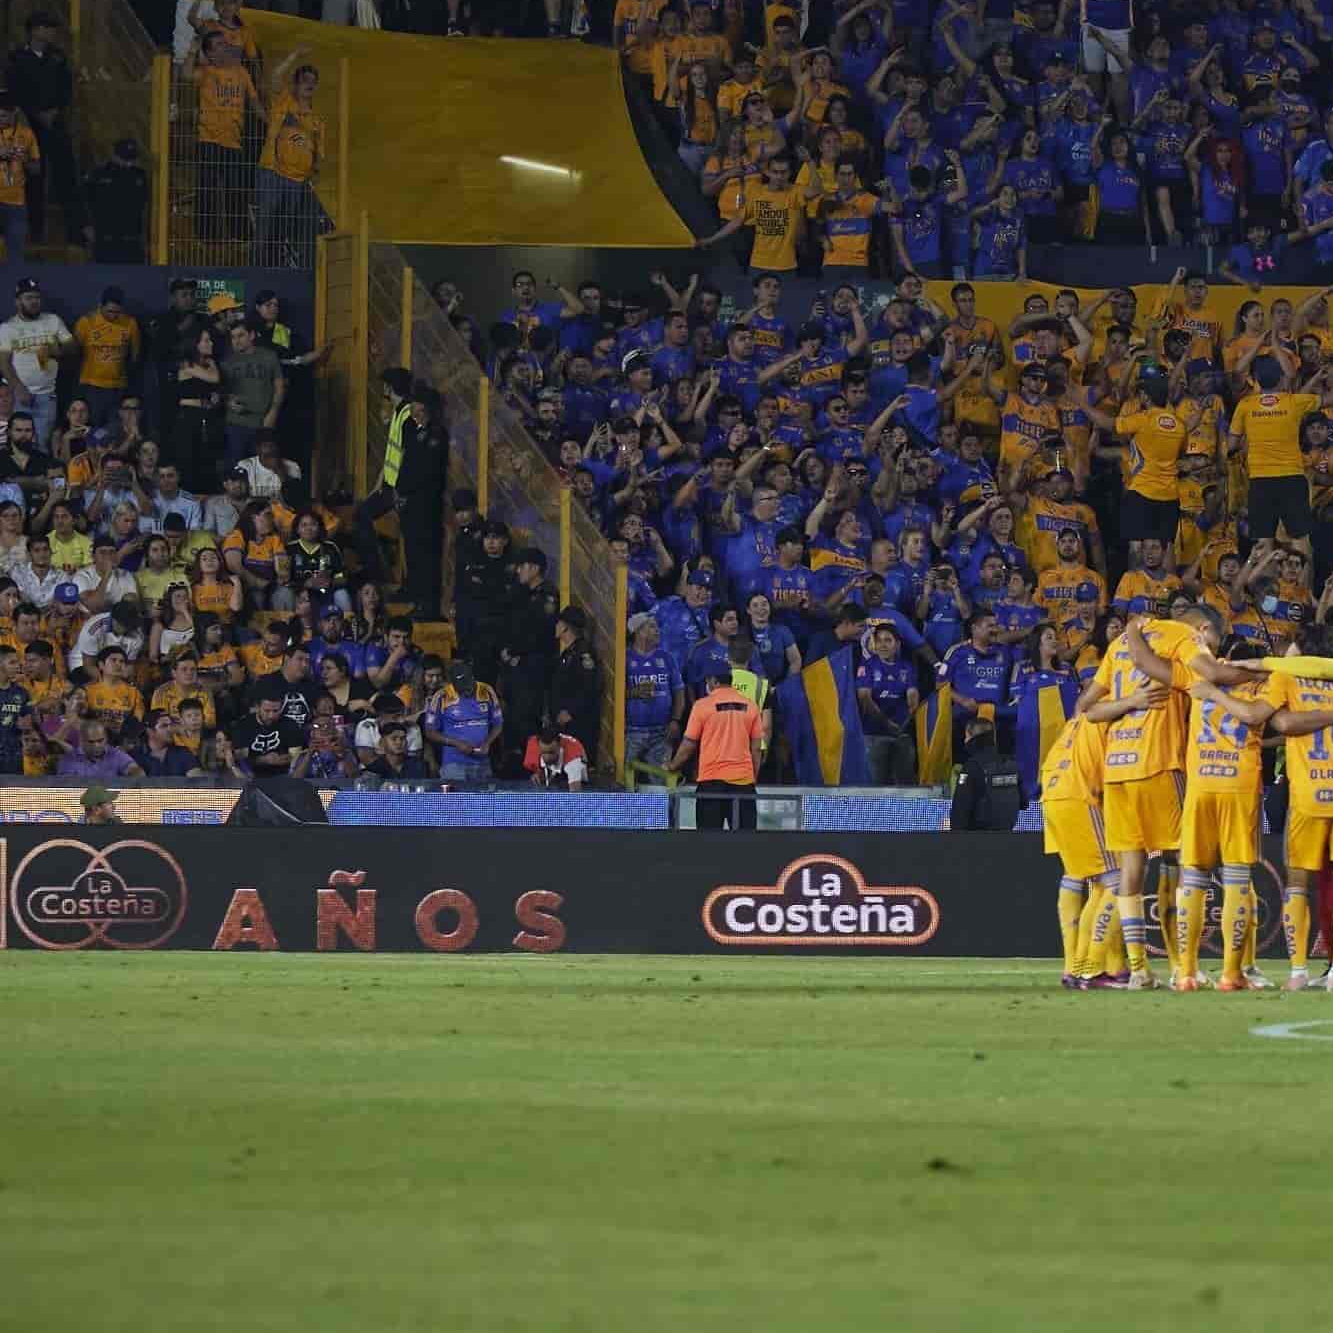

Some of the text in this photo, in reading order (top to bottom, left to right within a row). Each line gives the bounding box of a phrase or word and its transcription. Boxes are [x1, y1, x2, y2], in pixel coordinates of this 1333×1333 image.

[1199, 749, 1240, 761] GARZA
[87, 877, 112, 893] La
[802, 868, 840, 898] La
[41, 892, 157, 916] Costeña
[724, 893, 917, 935] Costeña
